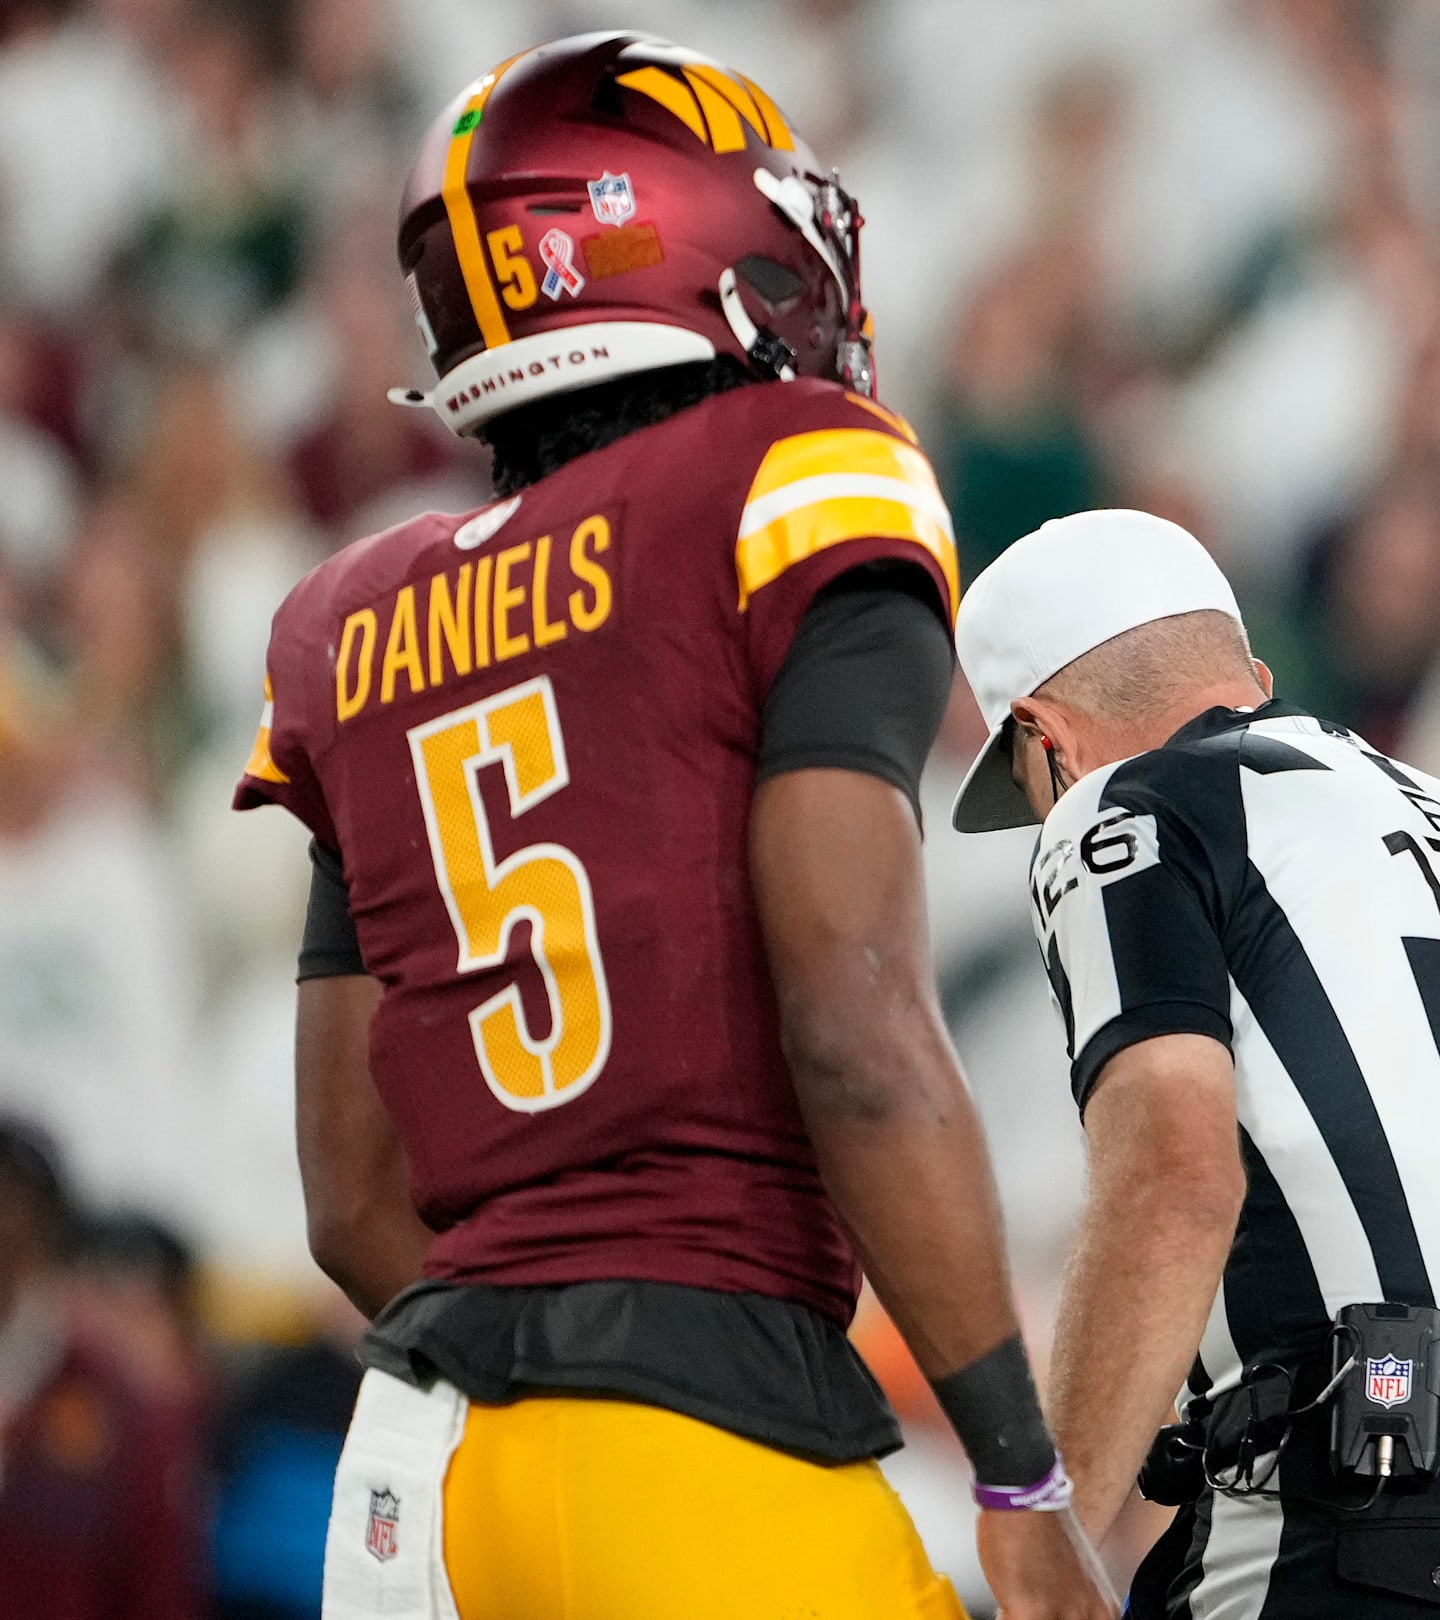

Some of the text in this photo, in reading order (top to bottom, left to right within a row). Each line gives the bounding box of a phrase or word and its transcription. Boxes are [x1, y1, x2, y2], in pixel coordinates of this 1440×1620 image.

[487, 225, 537, 310] 5
[446, 346, 609, 412] WASHINGTON
[336, 515, 612, 723] DANIELS
[406, 674, 613, 1114] 5
[1372, 1378, 1405, 1399] NFL
[369, 1516, 397, 1553] NFL
